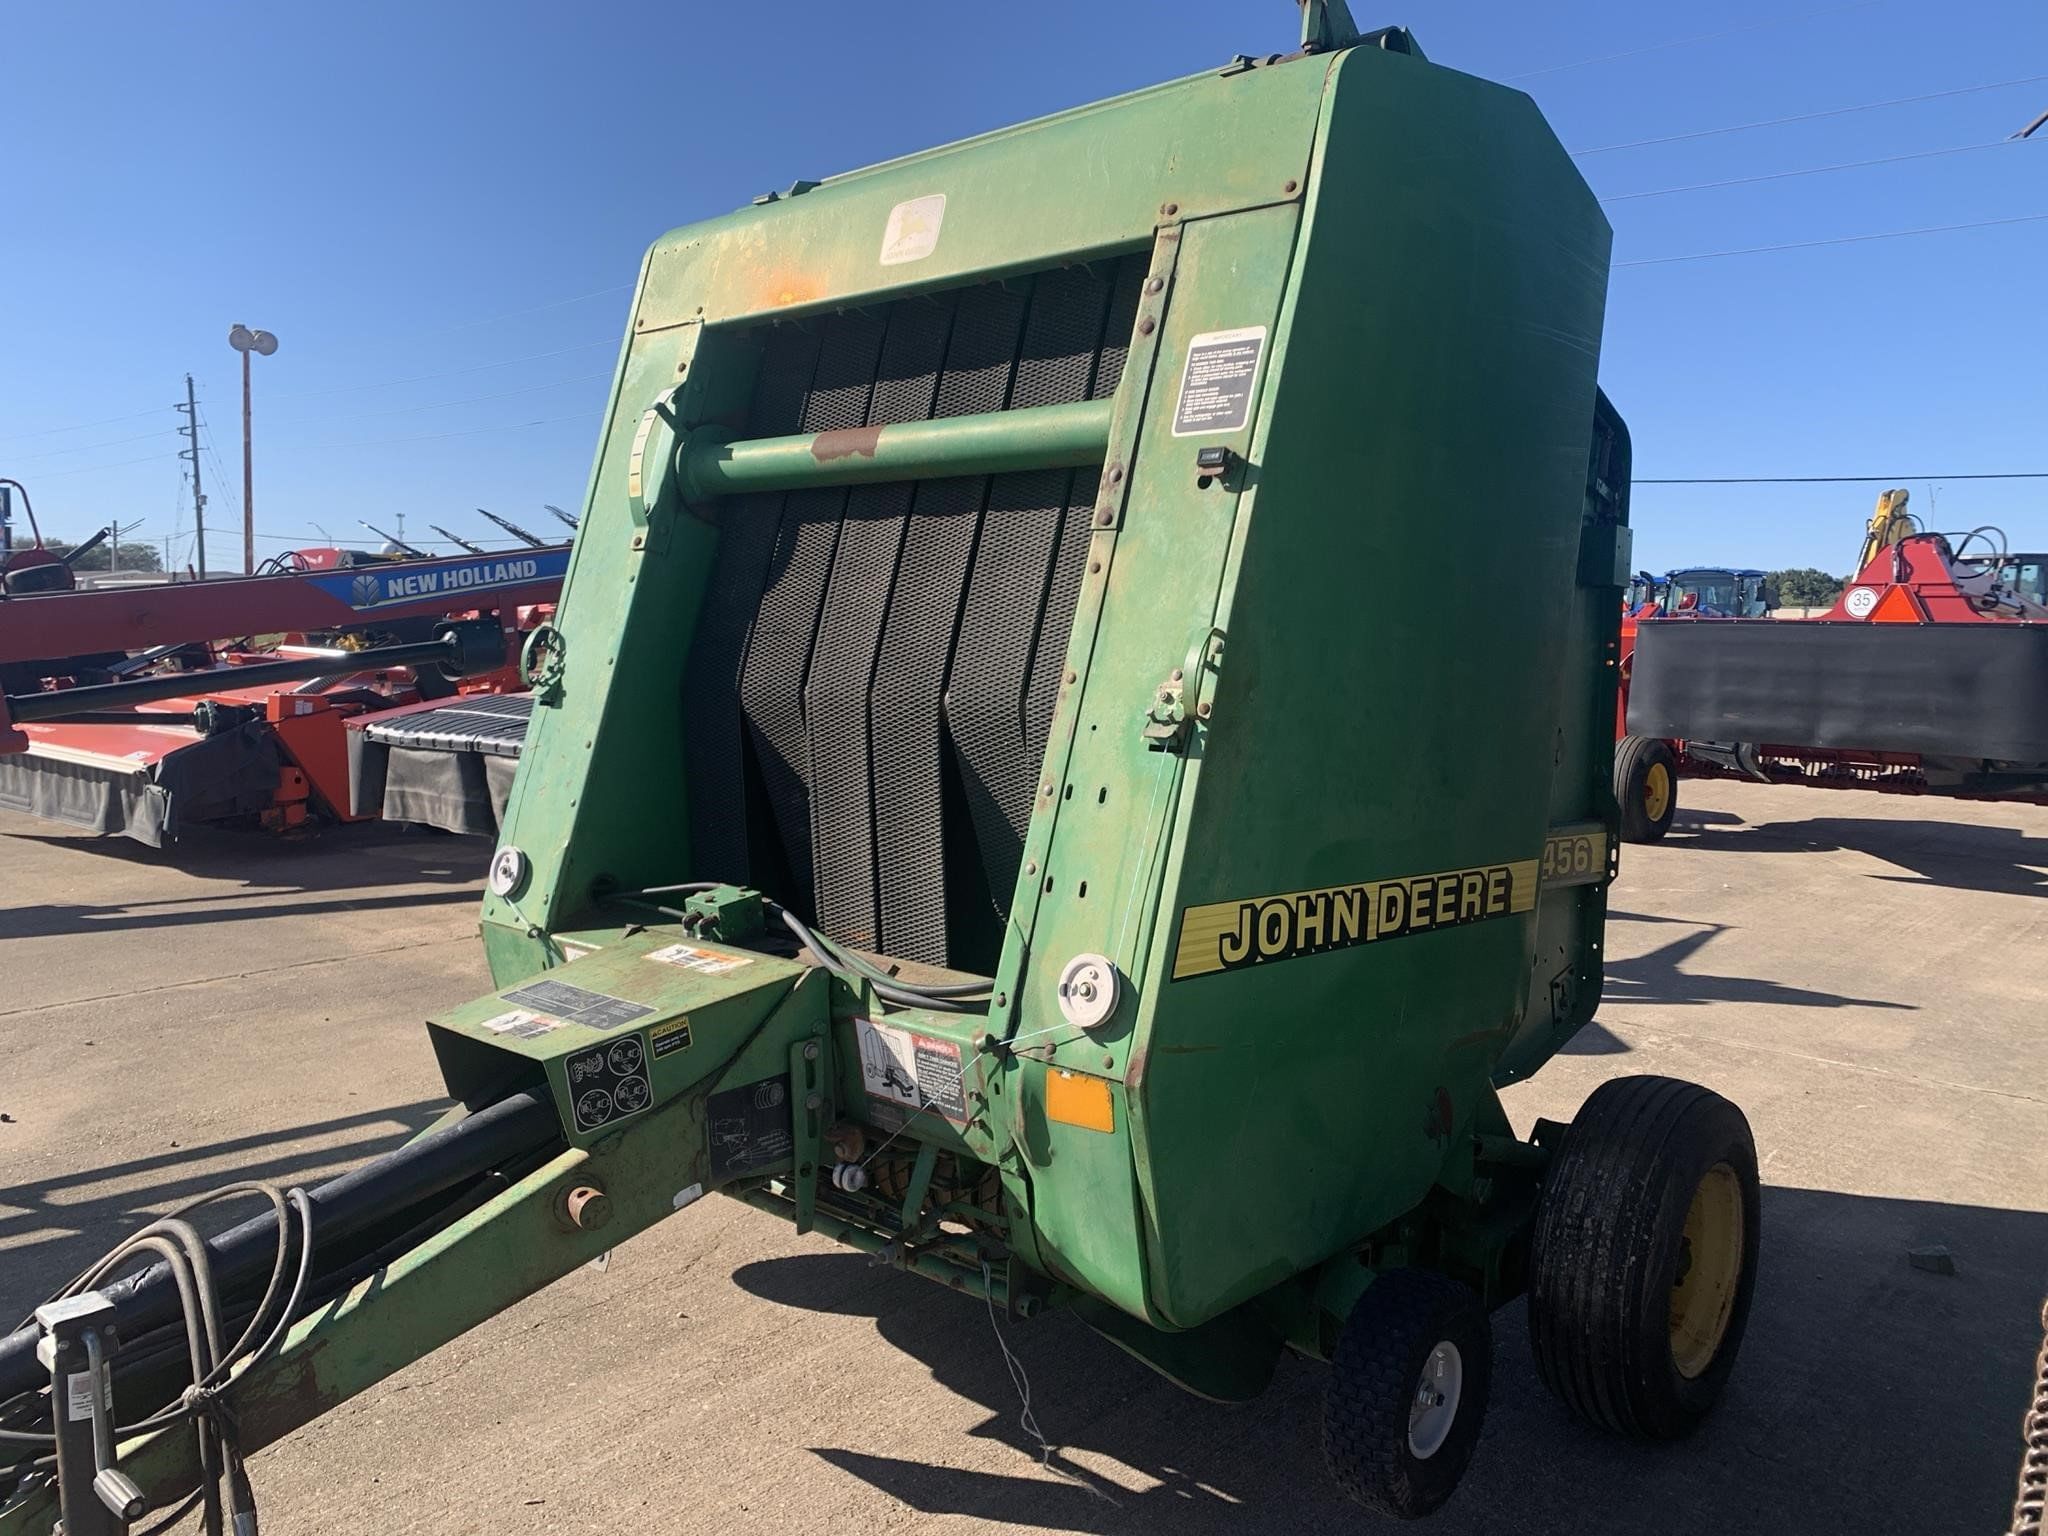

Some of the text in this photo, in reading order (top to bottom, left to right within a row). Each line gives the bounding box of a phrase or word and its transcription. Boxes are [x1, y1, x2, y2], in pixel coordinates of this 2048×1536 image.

[387, 560, 537, 598] NEW HOLLAND
[1853, 593, 1870, 607] 35
[1543, 838, 1590, 877] 456
[1219, 867, 1510, 964] JOHN DEERE
[657, 1020, 687, 1036] CAUTION
